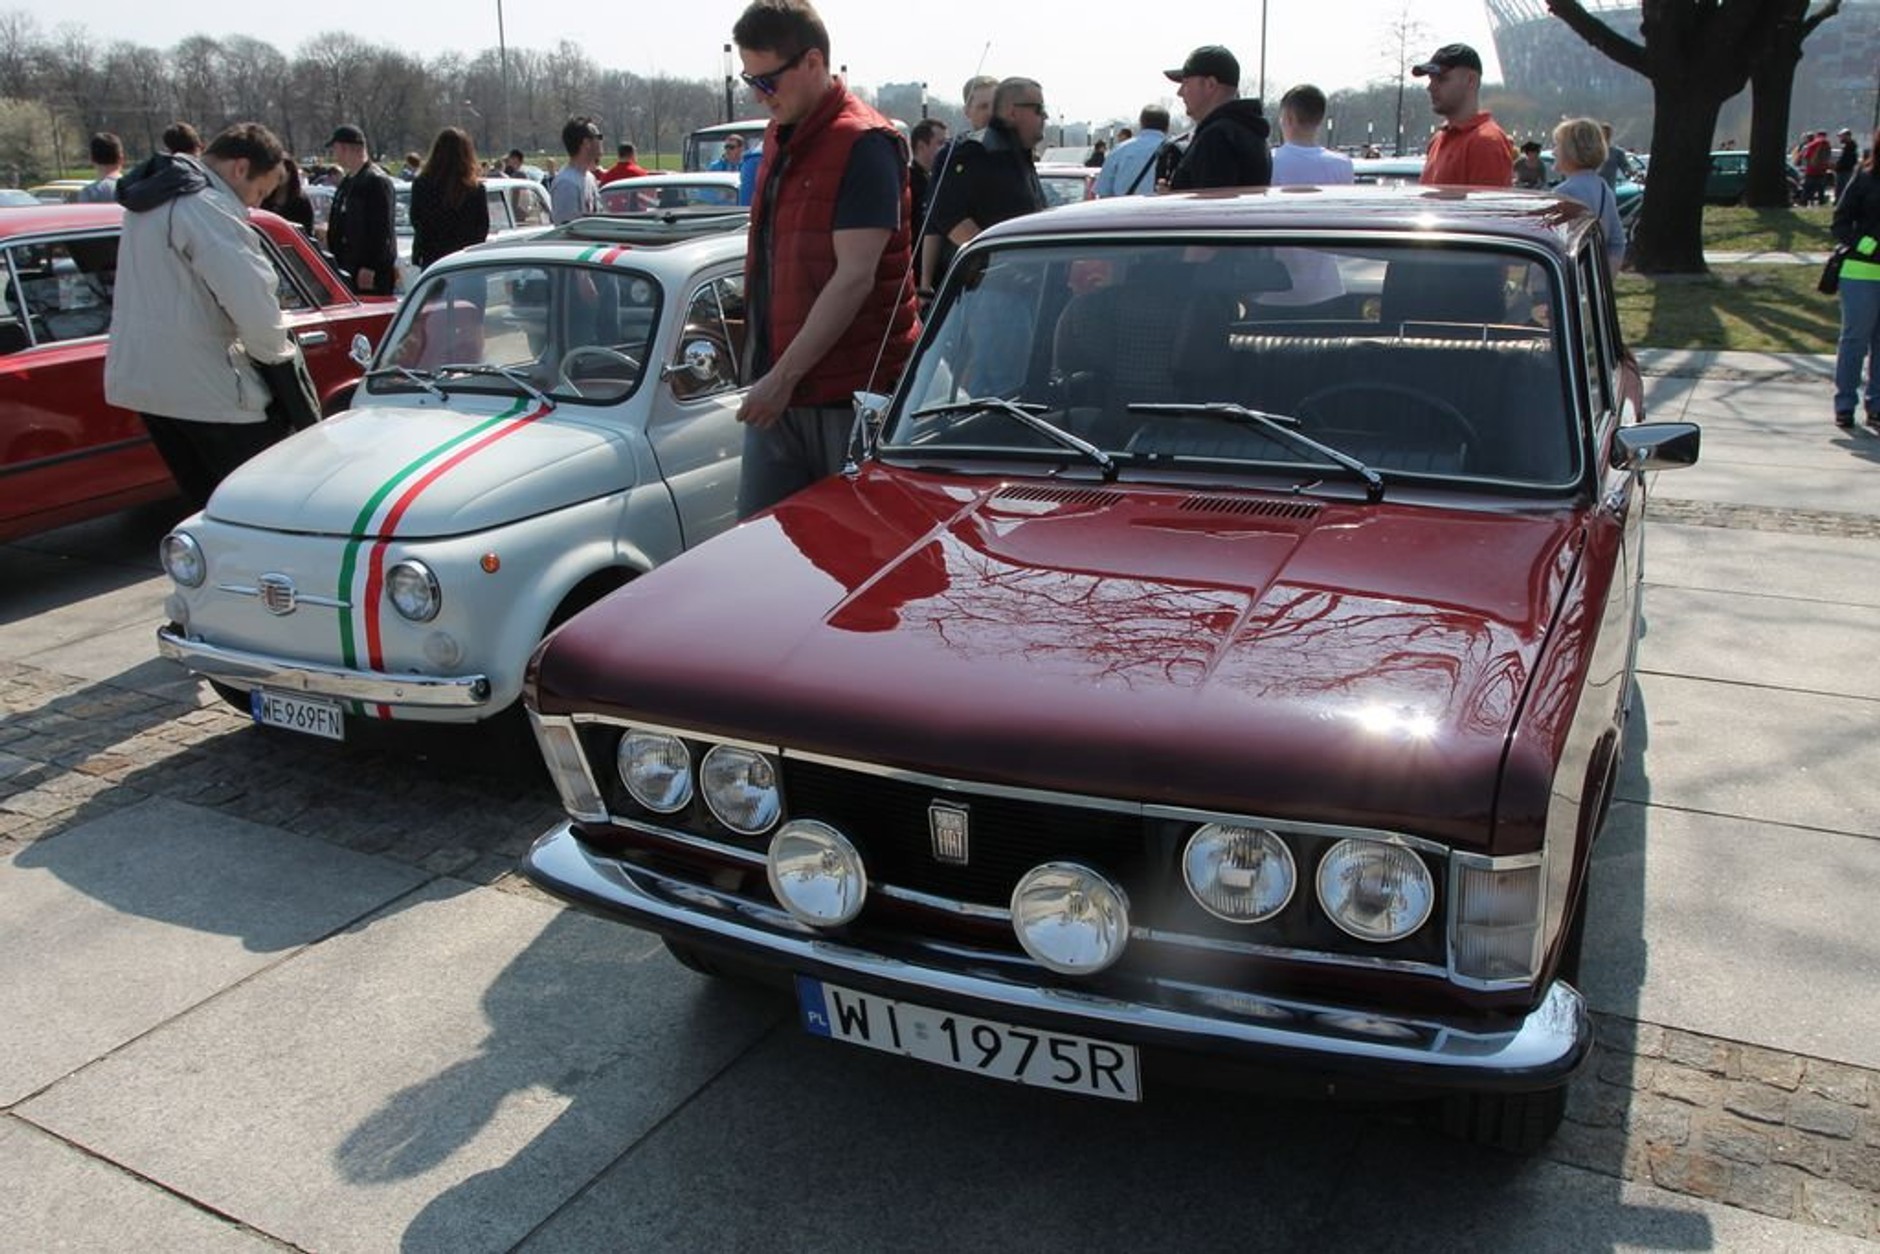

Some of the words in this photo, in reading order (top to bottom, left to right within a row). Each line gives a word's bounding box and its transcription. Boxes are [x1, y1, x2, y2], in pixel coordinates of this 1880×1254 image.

[263, 697, 339, 735] WE969FN
[807, 1010, 828, 1027] PL
[832, 991, 902, 1049] WI
[939, 1017, 1126, 1094] 1975R
